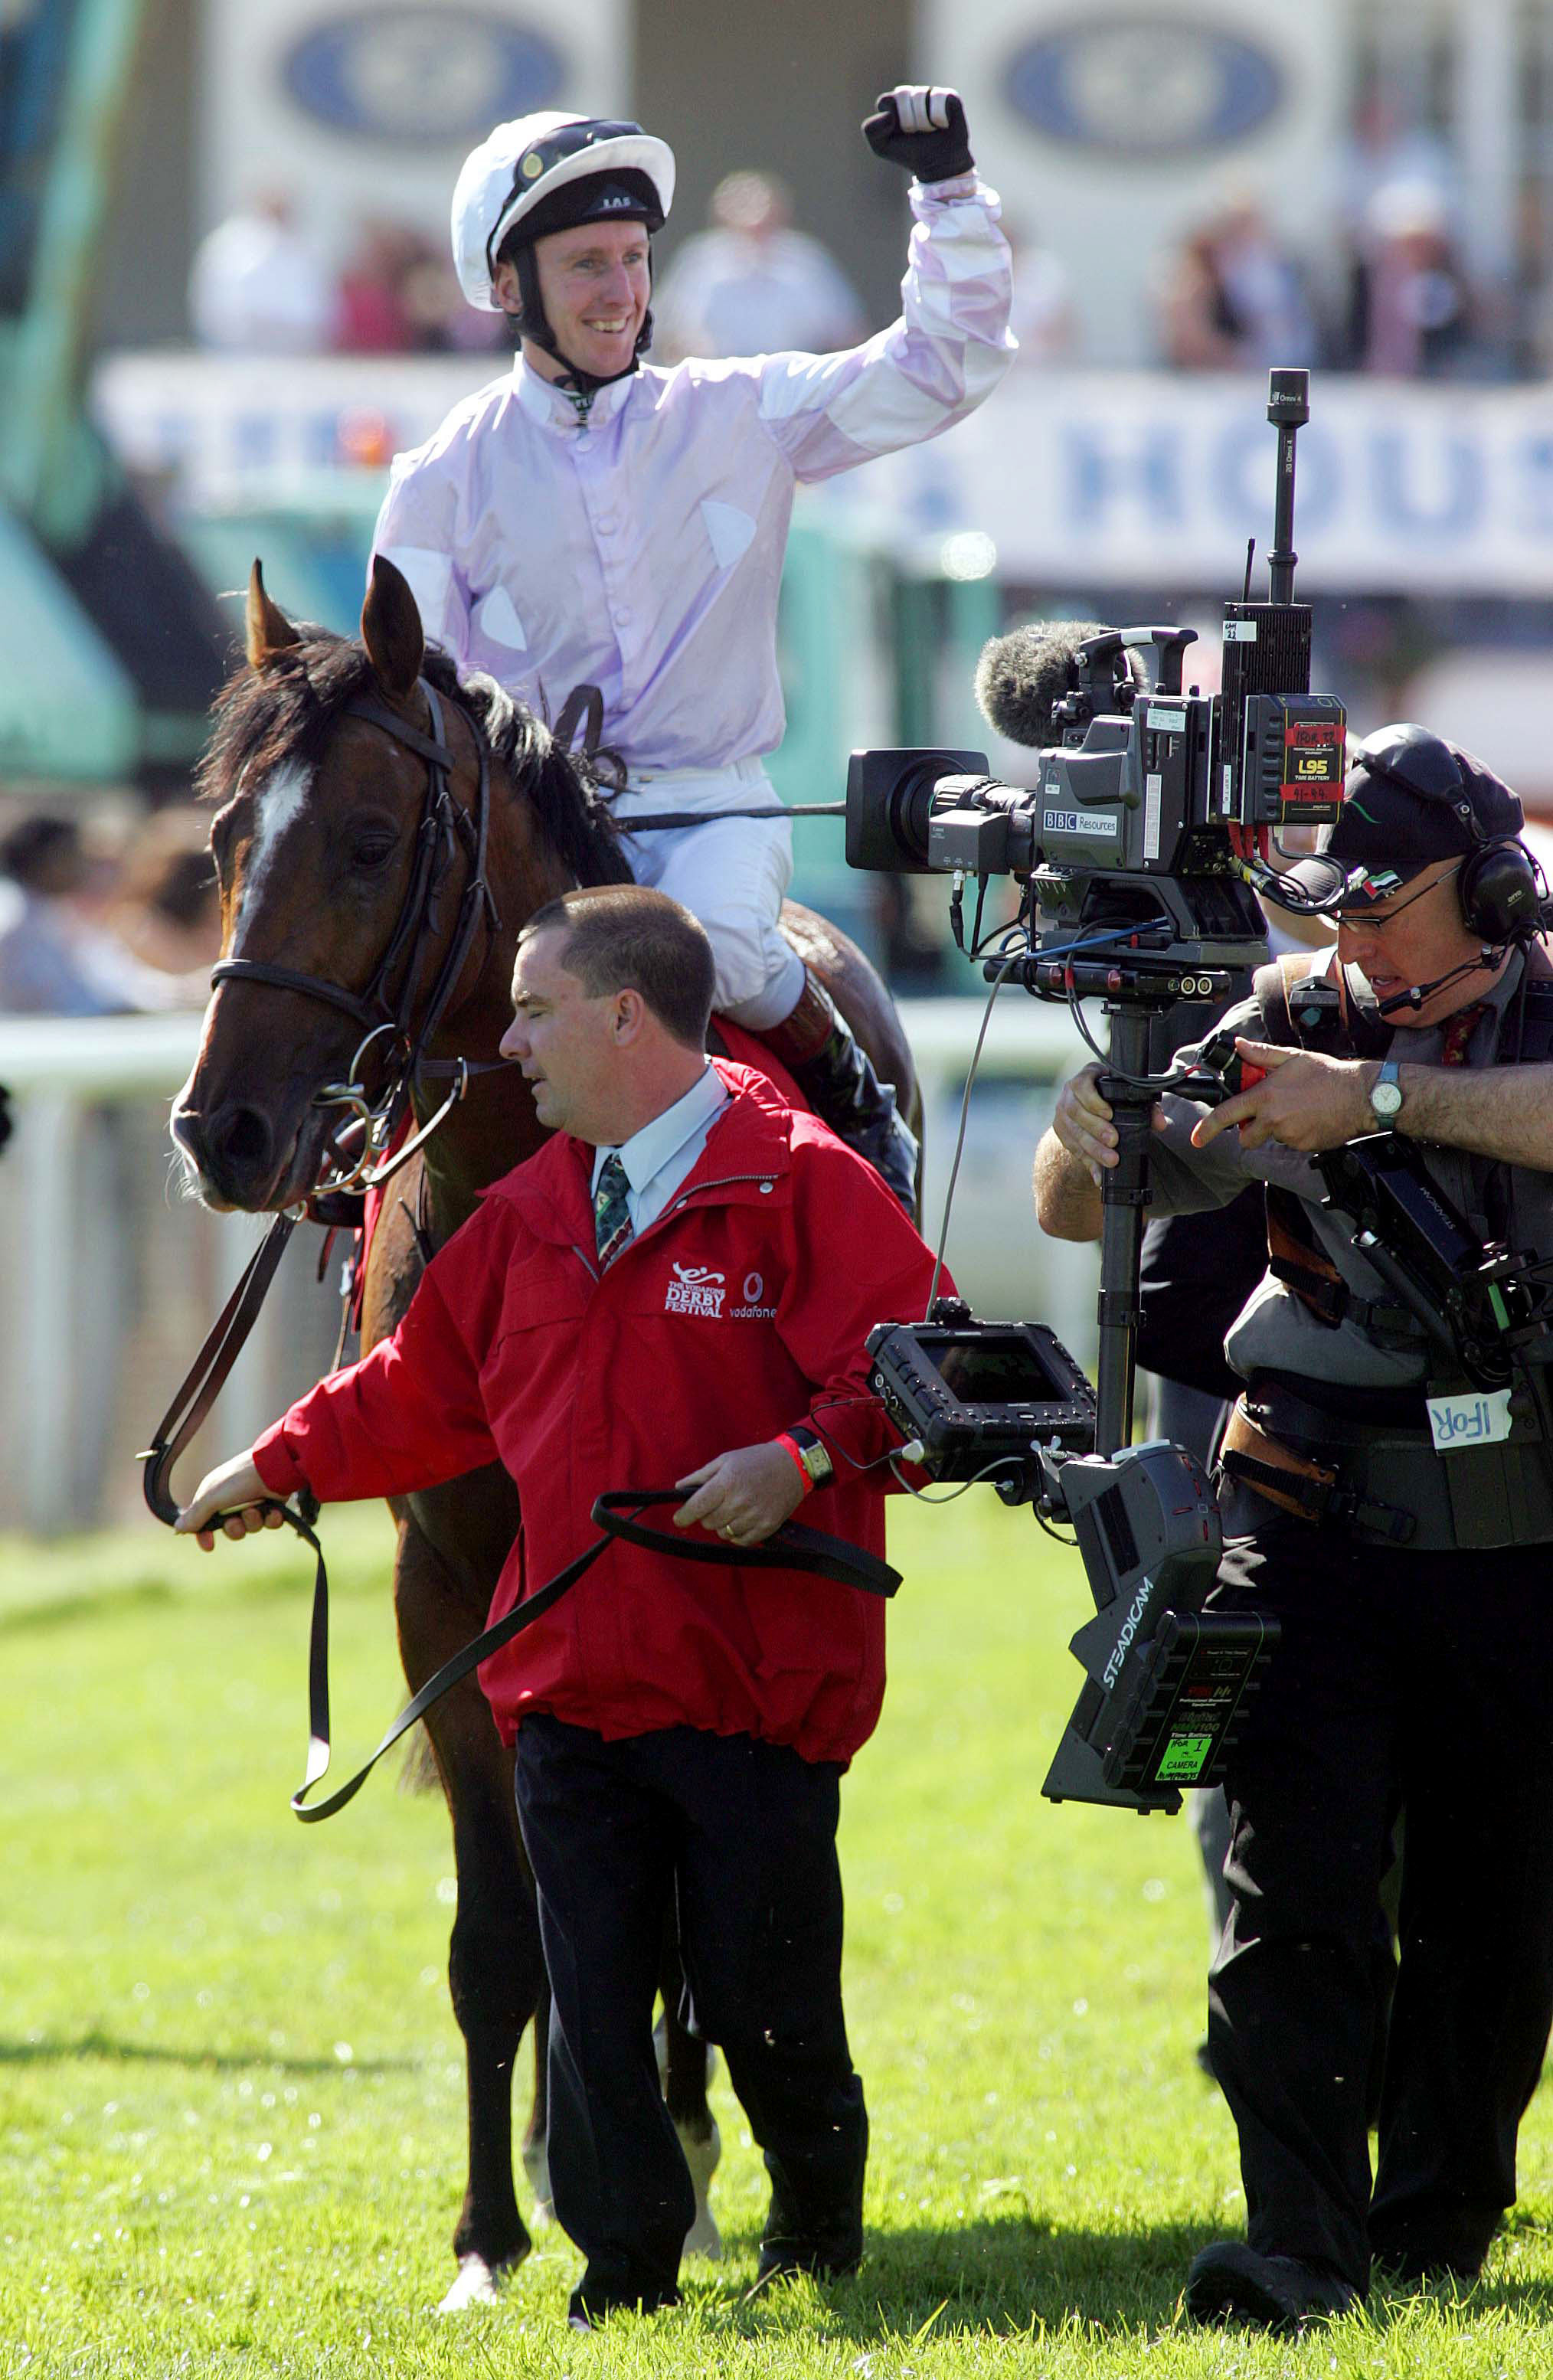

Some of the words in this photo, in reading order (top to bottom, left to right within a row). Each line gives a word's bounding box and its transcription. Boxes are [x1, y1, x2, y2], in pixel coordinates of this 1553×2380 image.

[1227, 630, 1237, 640] 22
[1298, 760, 1328, 775] L95
[1046, 812, 1077, 830] BBC
[1079, 816, 1116, 831] Resources
[669, 1280, 684, 1292] THE
[685, 1284, 726, 1296] VODAFONE
[665, 1288, 726, 1307] DERBY
[664, 1300, 723, 1319] FESTIVAL
[729, 1306, 777, 1318] vodafone
[1103, 1576, 1154, 1689] STEADICAM
[1166, 1760, 1198, 1770] CAMERA
